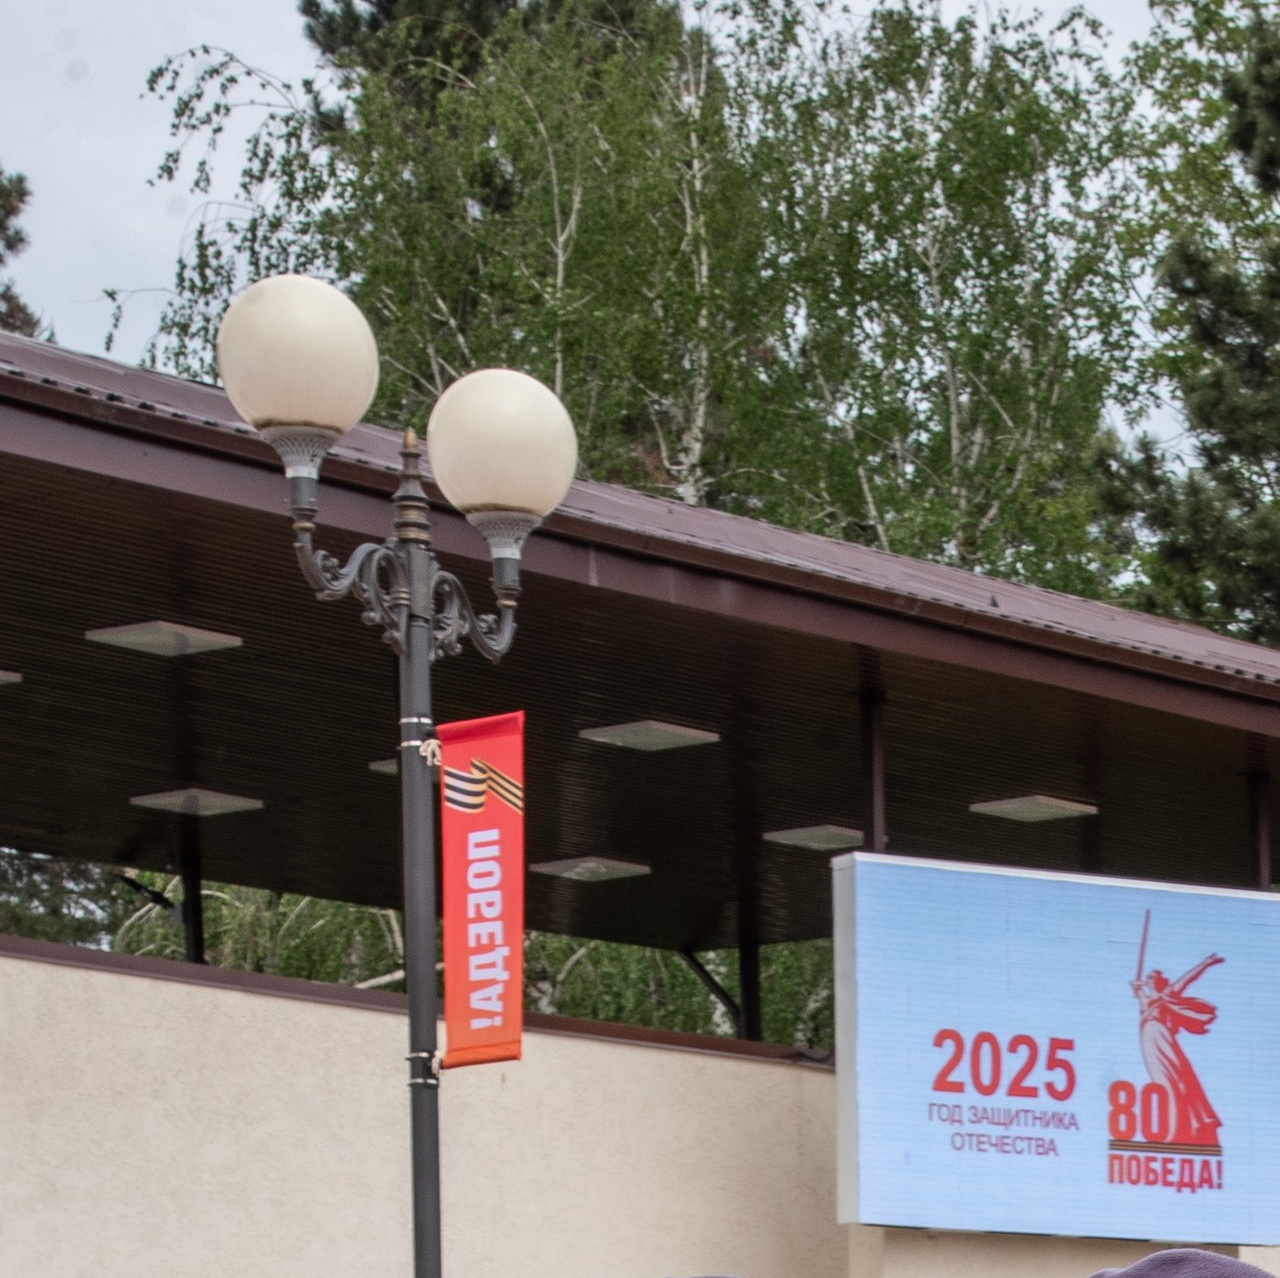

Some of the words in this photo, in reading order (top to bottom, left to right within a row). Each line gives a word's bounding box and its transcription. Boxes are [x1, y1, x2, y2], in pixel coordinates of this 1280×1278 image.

[931, 1028, 1077, 1102] 2025
[928, 1102, 963, 1125] ГОД
[968, 1104, 1079, 1131] ЗАЩИТНИКА
[1107, 1080, 1172, 1142] 80
[951, 1131, 1058, 1157] ОТЕЧЕСТВА
[1108, 1153, 1223, 1193] ПОБЕДА!
